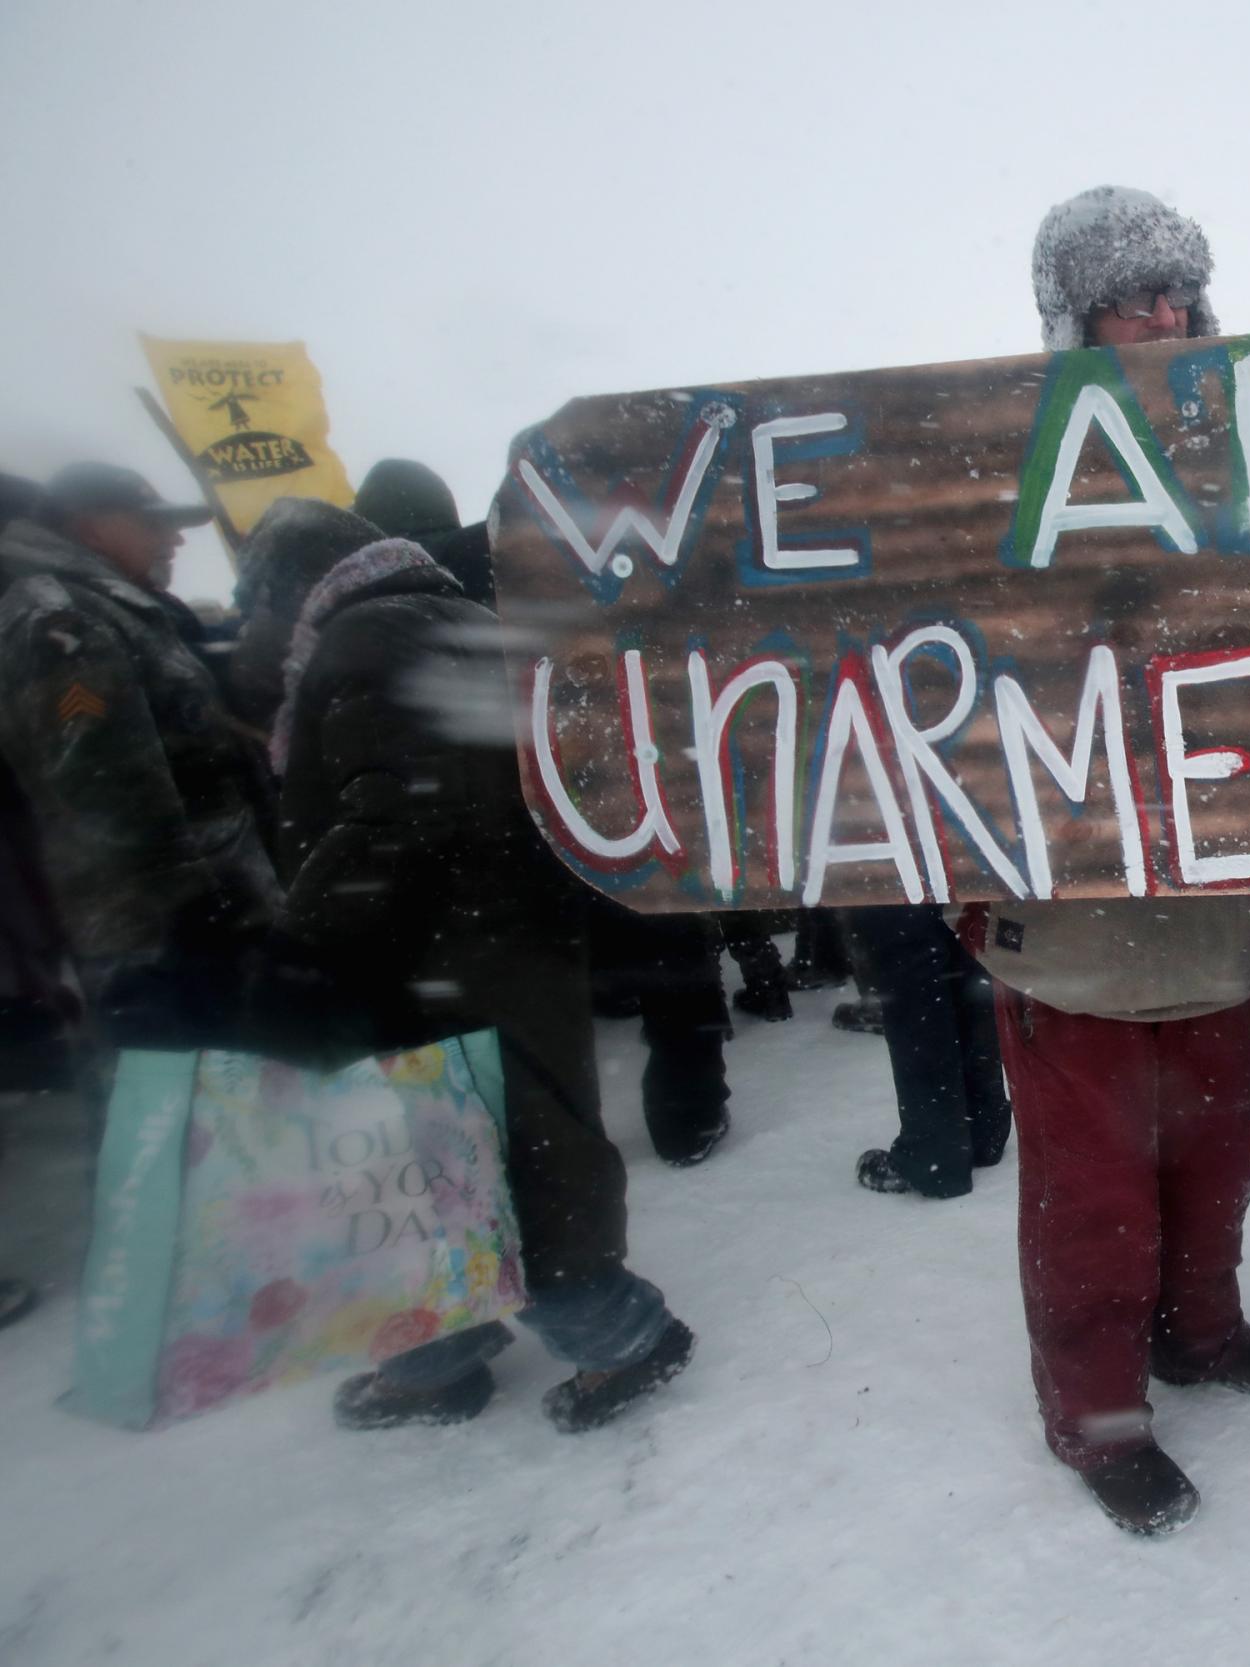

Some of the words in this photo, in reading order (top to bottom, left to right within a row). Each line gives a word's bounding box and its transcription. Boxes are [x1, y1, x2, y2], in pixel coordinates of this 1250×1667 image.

[168, 366, 284, 386] PROTECT
[207, 438, 299, 465] WATER
[232, 462, 247, 472] IS
[250, 459, 282, 471] LIFE
[515, 405, 862, 578] WE
